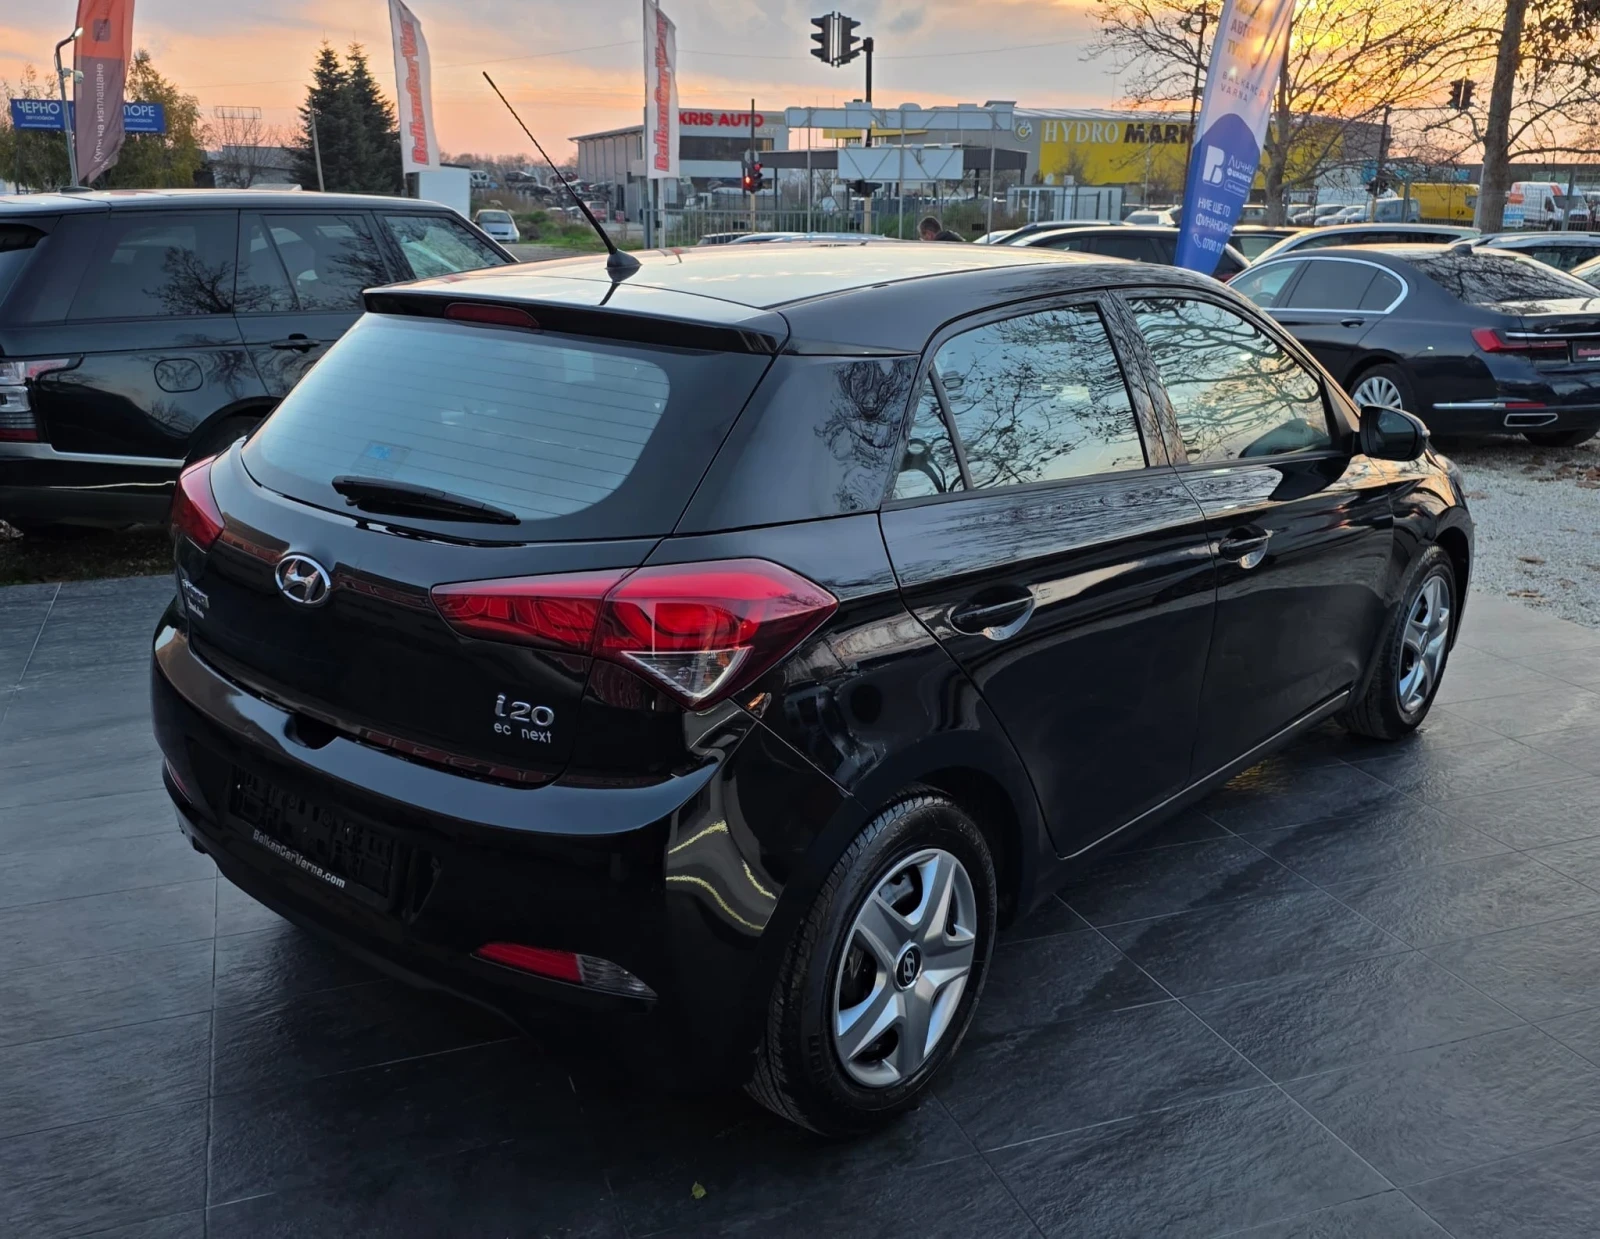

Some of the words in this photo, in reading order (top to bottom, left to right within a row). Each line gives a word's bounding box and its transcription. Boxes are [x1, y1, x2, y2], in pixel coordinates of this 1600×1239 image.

[96, 63, 105, 123] изплащане
[1220, 82, 1248, 102] VARNA
[16, 101, 60, 114] ЧЕРНО
[678, 111, 714, 126] KRIS
[717, 112, 765, 128] AUTO
[1044, 121, 1119, 143] HYDRO
[494, 694, 555, 727] i20
[493, 722, 512, 735] ec
[521, 728, 552, 744] next
[253, 829, 346, 888] BalkanCarVarna.com
